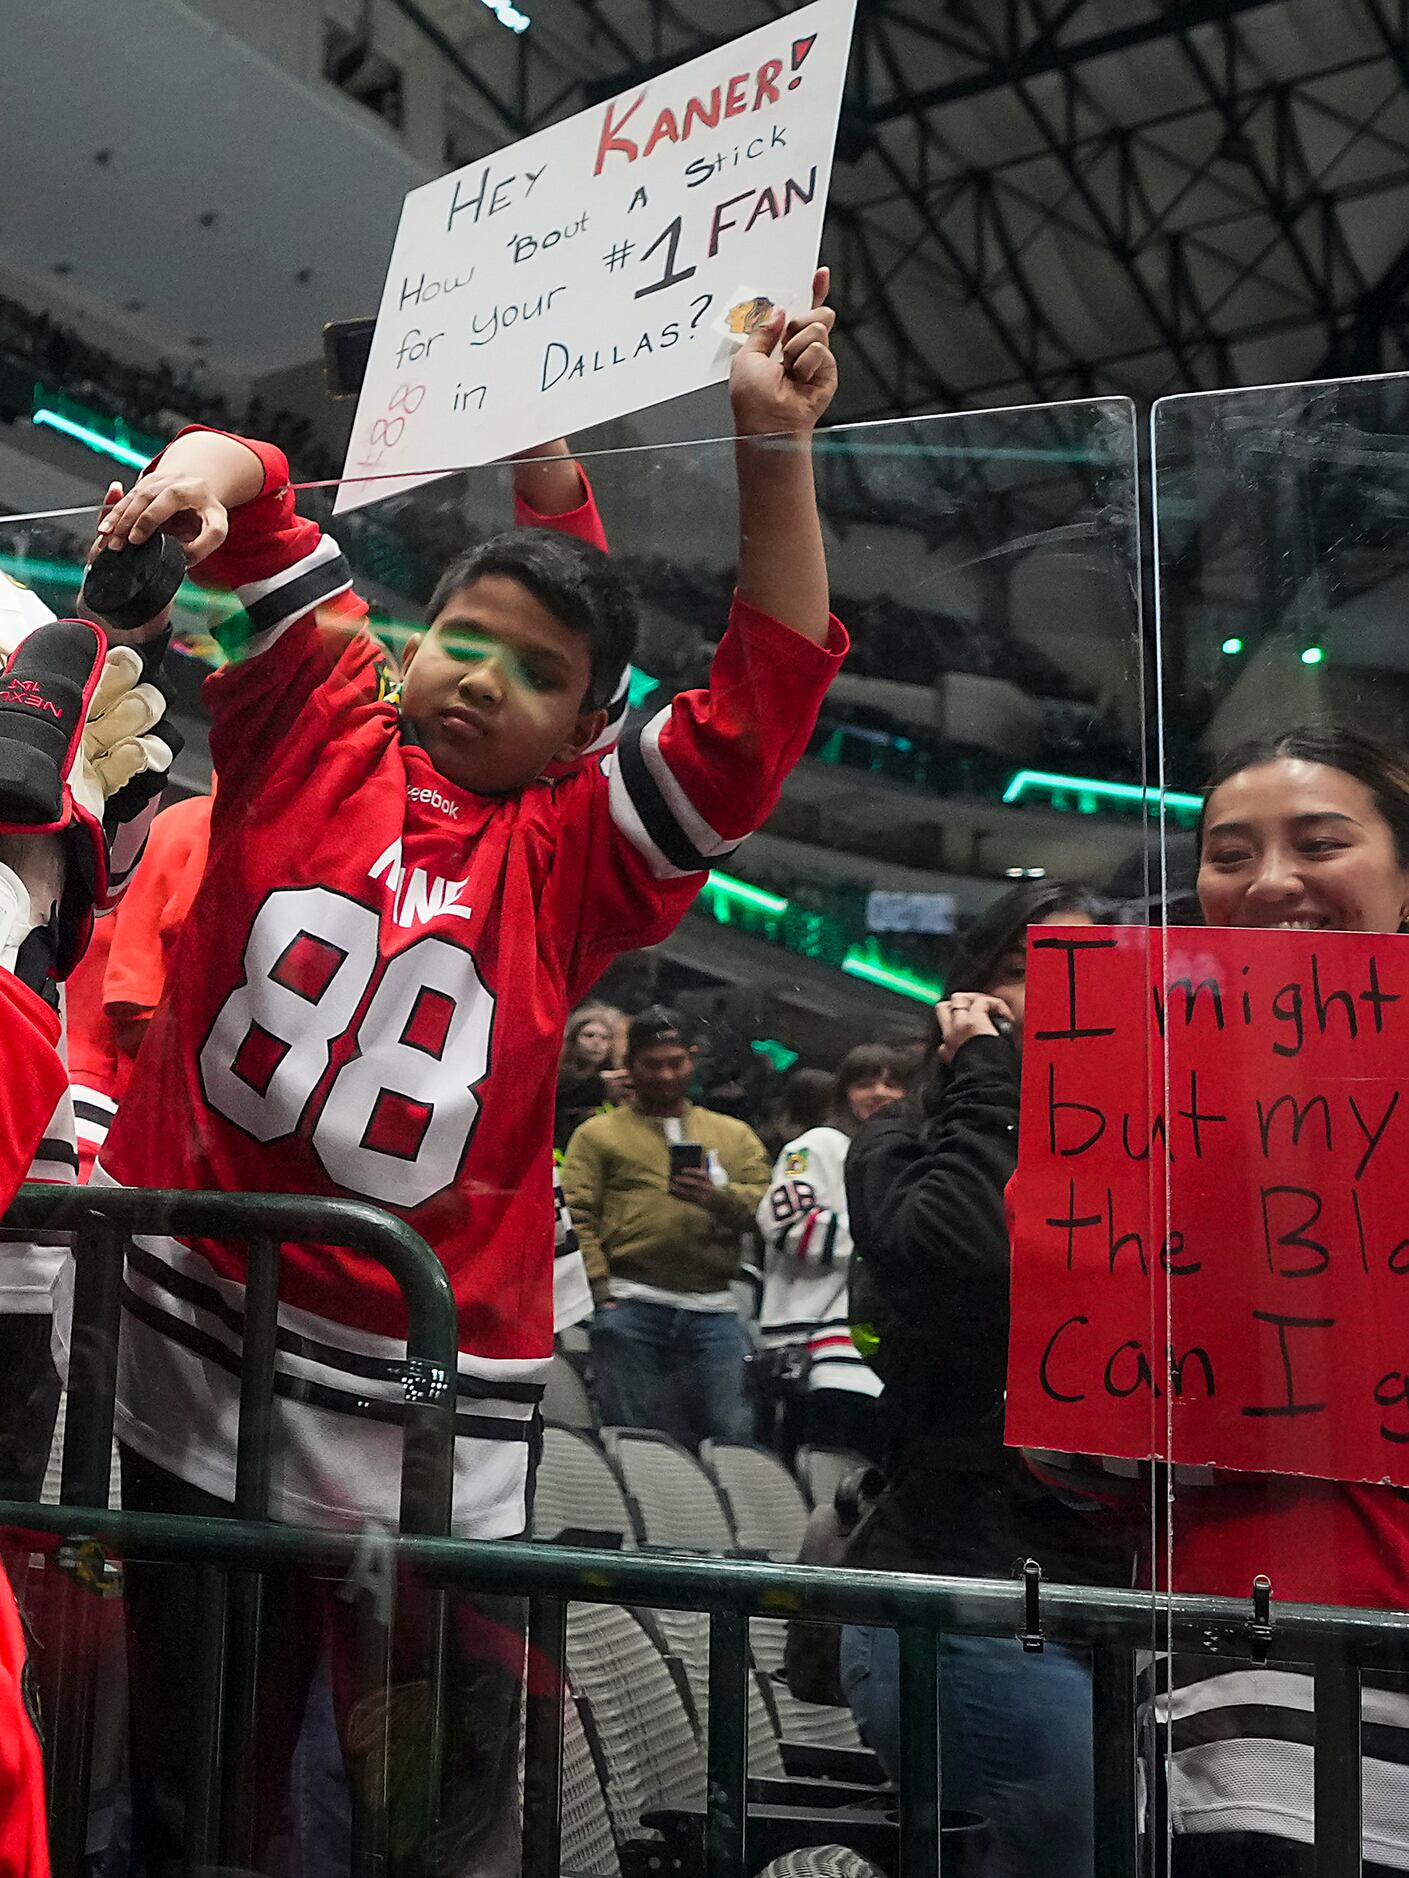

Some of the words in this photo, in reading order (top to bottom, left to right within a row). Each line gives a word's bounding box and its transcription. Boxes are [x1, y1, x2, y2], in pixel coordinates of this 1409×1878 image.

[447, 164, 549, 232] HEY
[592, 33, 819, 178] KANER!
[395, 327, 446, 370] for
[470, 285, 567, 347] your
[707, 165, 818, 258] FAN
[398, 267, 475, 312] How
[627, 185, 649, 214] A
[452, 383, 488, 412] in
[539, 293, 715, 392] DALLAS?
[198, 884, 497, 1211] 88
[1033, 938, 1119, 1041] I
[1152, 953, 1400, 1057] might
[1048, 1062, 1227, 1162] but
[1256, 1090, 1400, 1182] my
[1045, 1177, 1202, 1277] the
[1039, 1315, 1216, 1403] Can
[1242, 1310, 1335, 1418] I
